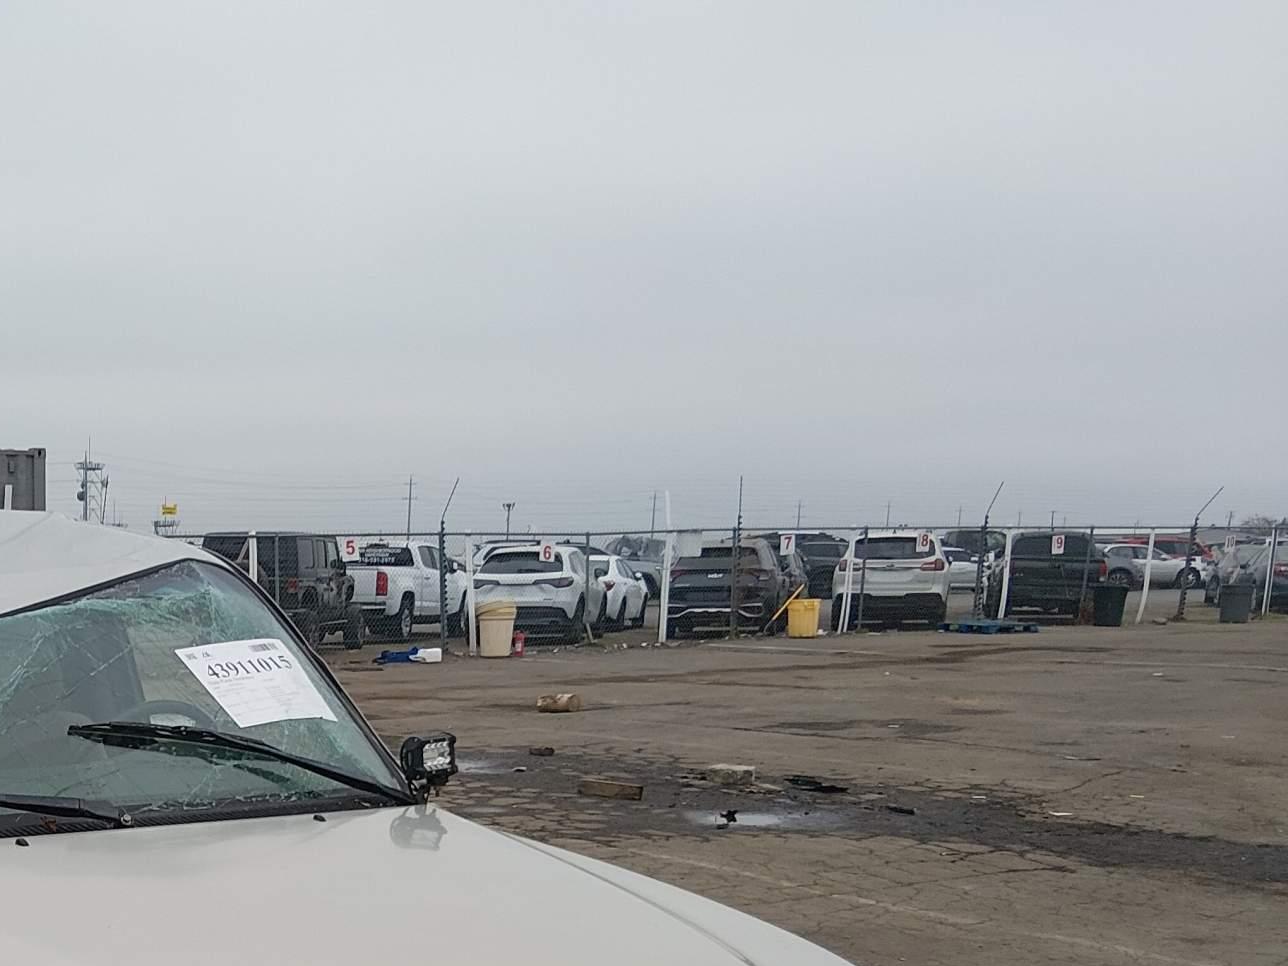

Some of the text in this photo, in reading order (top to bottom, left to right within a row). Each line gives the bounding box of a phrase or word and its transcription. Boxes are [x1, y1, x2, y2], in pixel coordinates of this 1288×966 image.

[783, 536, 793, 550] 7
[920, 533, 929, 547] 8
[1056, 536, 1064, 549] 9
[1226, 536, 1235, 548] 10
[345, 540, 356, 555] 5
[543, 545, 552, 560] 6
[207, 655, 292, 678] 43911015
